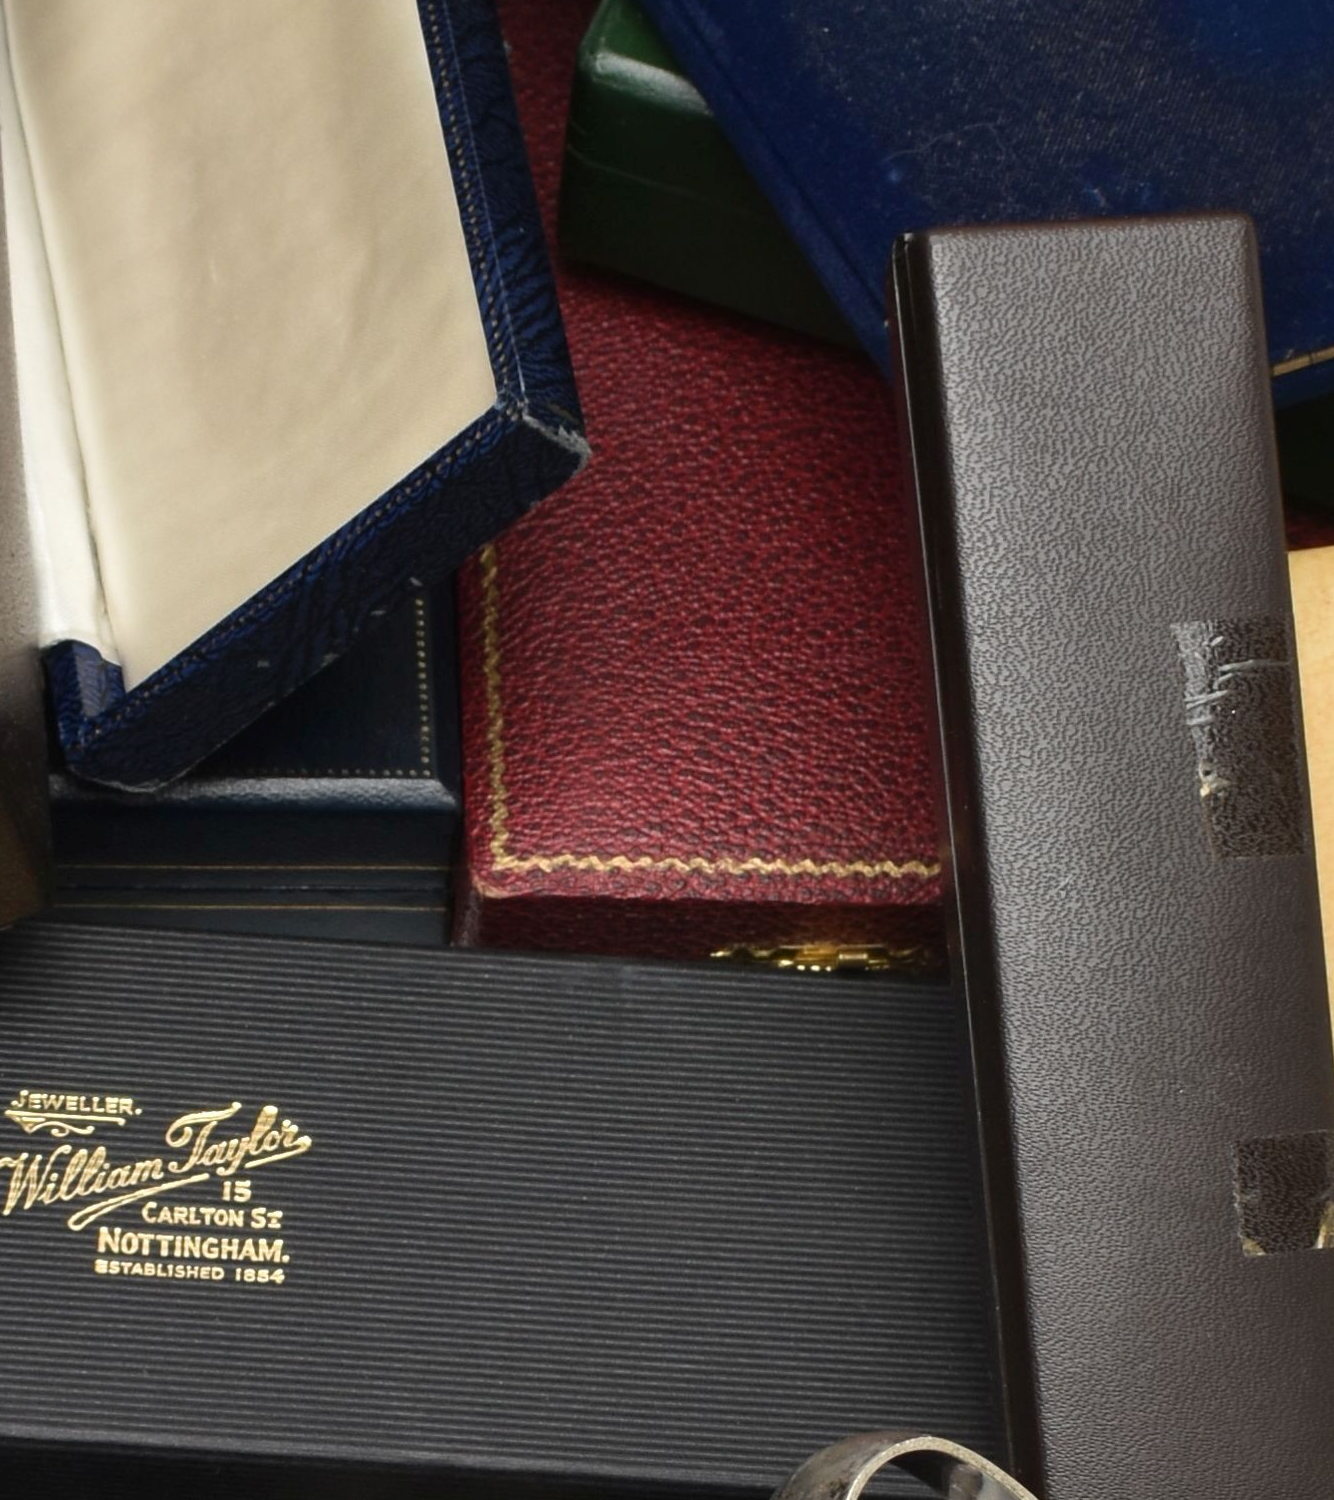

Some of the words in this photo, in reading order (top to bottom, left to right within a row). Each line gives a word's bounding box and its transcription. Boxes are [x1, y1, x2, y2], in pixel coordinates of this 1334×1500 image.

[11, 1090, 143, 1115] JEWELLER.
[166, 1102, 312, 1176] Taylor
[222, 1180, 252, 1202] 15
[142, 1202, 244, 1228] CARLTON
[97, 1227, 290, 1263] NOTTINGHAM.
[94, 1260, 225, 1281] ESTABLISHED
[235, 1268, 285, 1284] 1854
